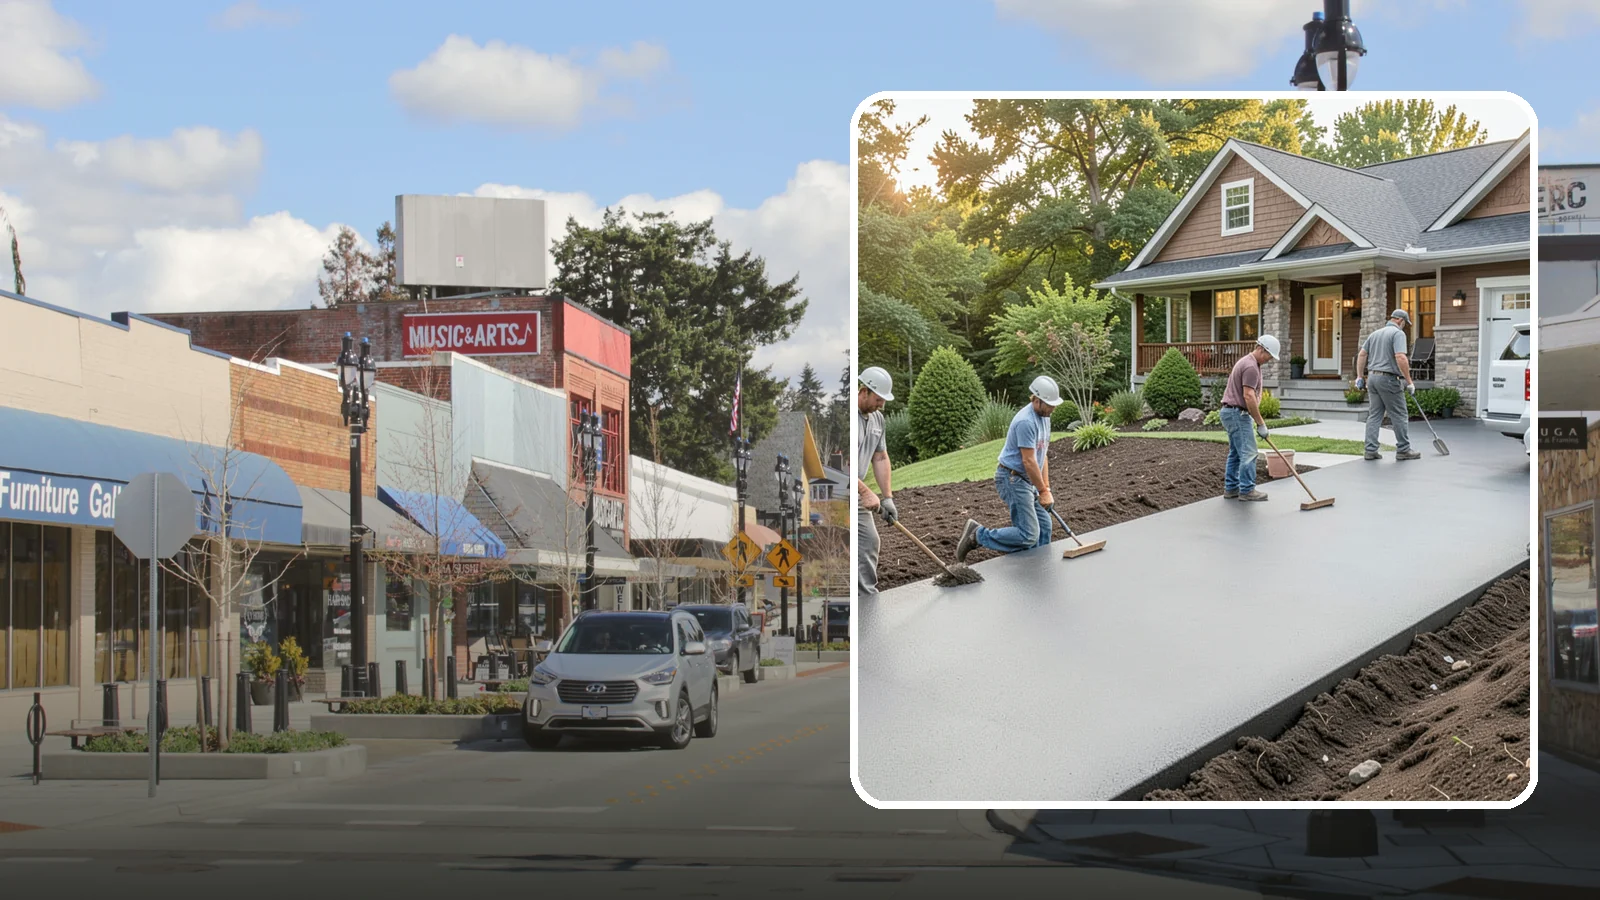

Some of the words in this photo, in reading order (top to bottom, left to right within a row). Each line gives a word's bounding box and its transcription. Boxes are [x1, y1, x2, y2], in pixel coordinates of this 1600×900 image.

[408, 323, 520, 349] MUSIC&ARTS
[0, 471, 79, 515] Furniture
[453, 563, 479, 574] SUSHI
